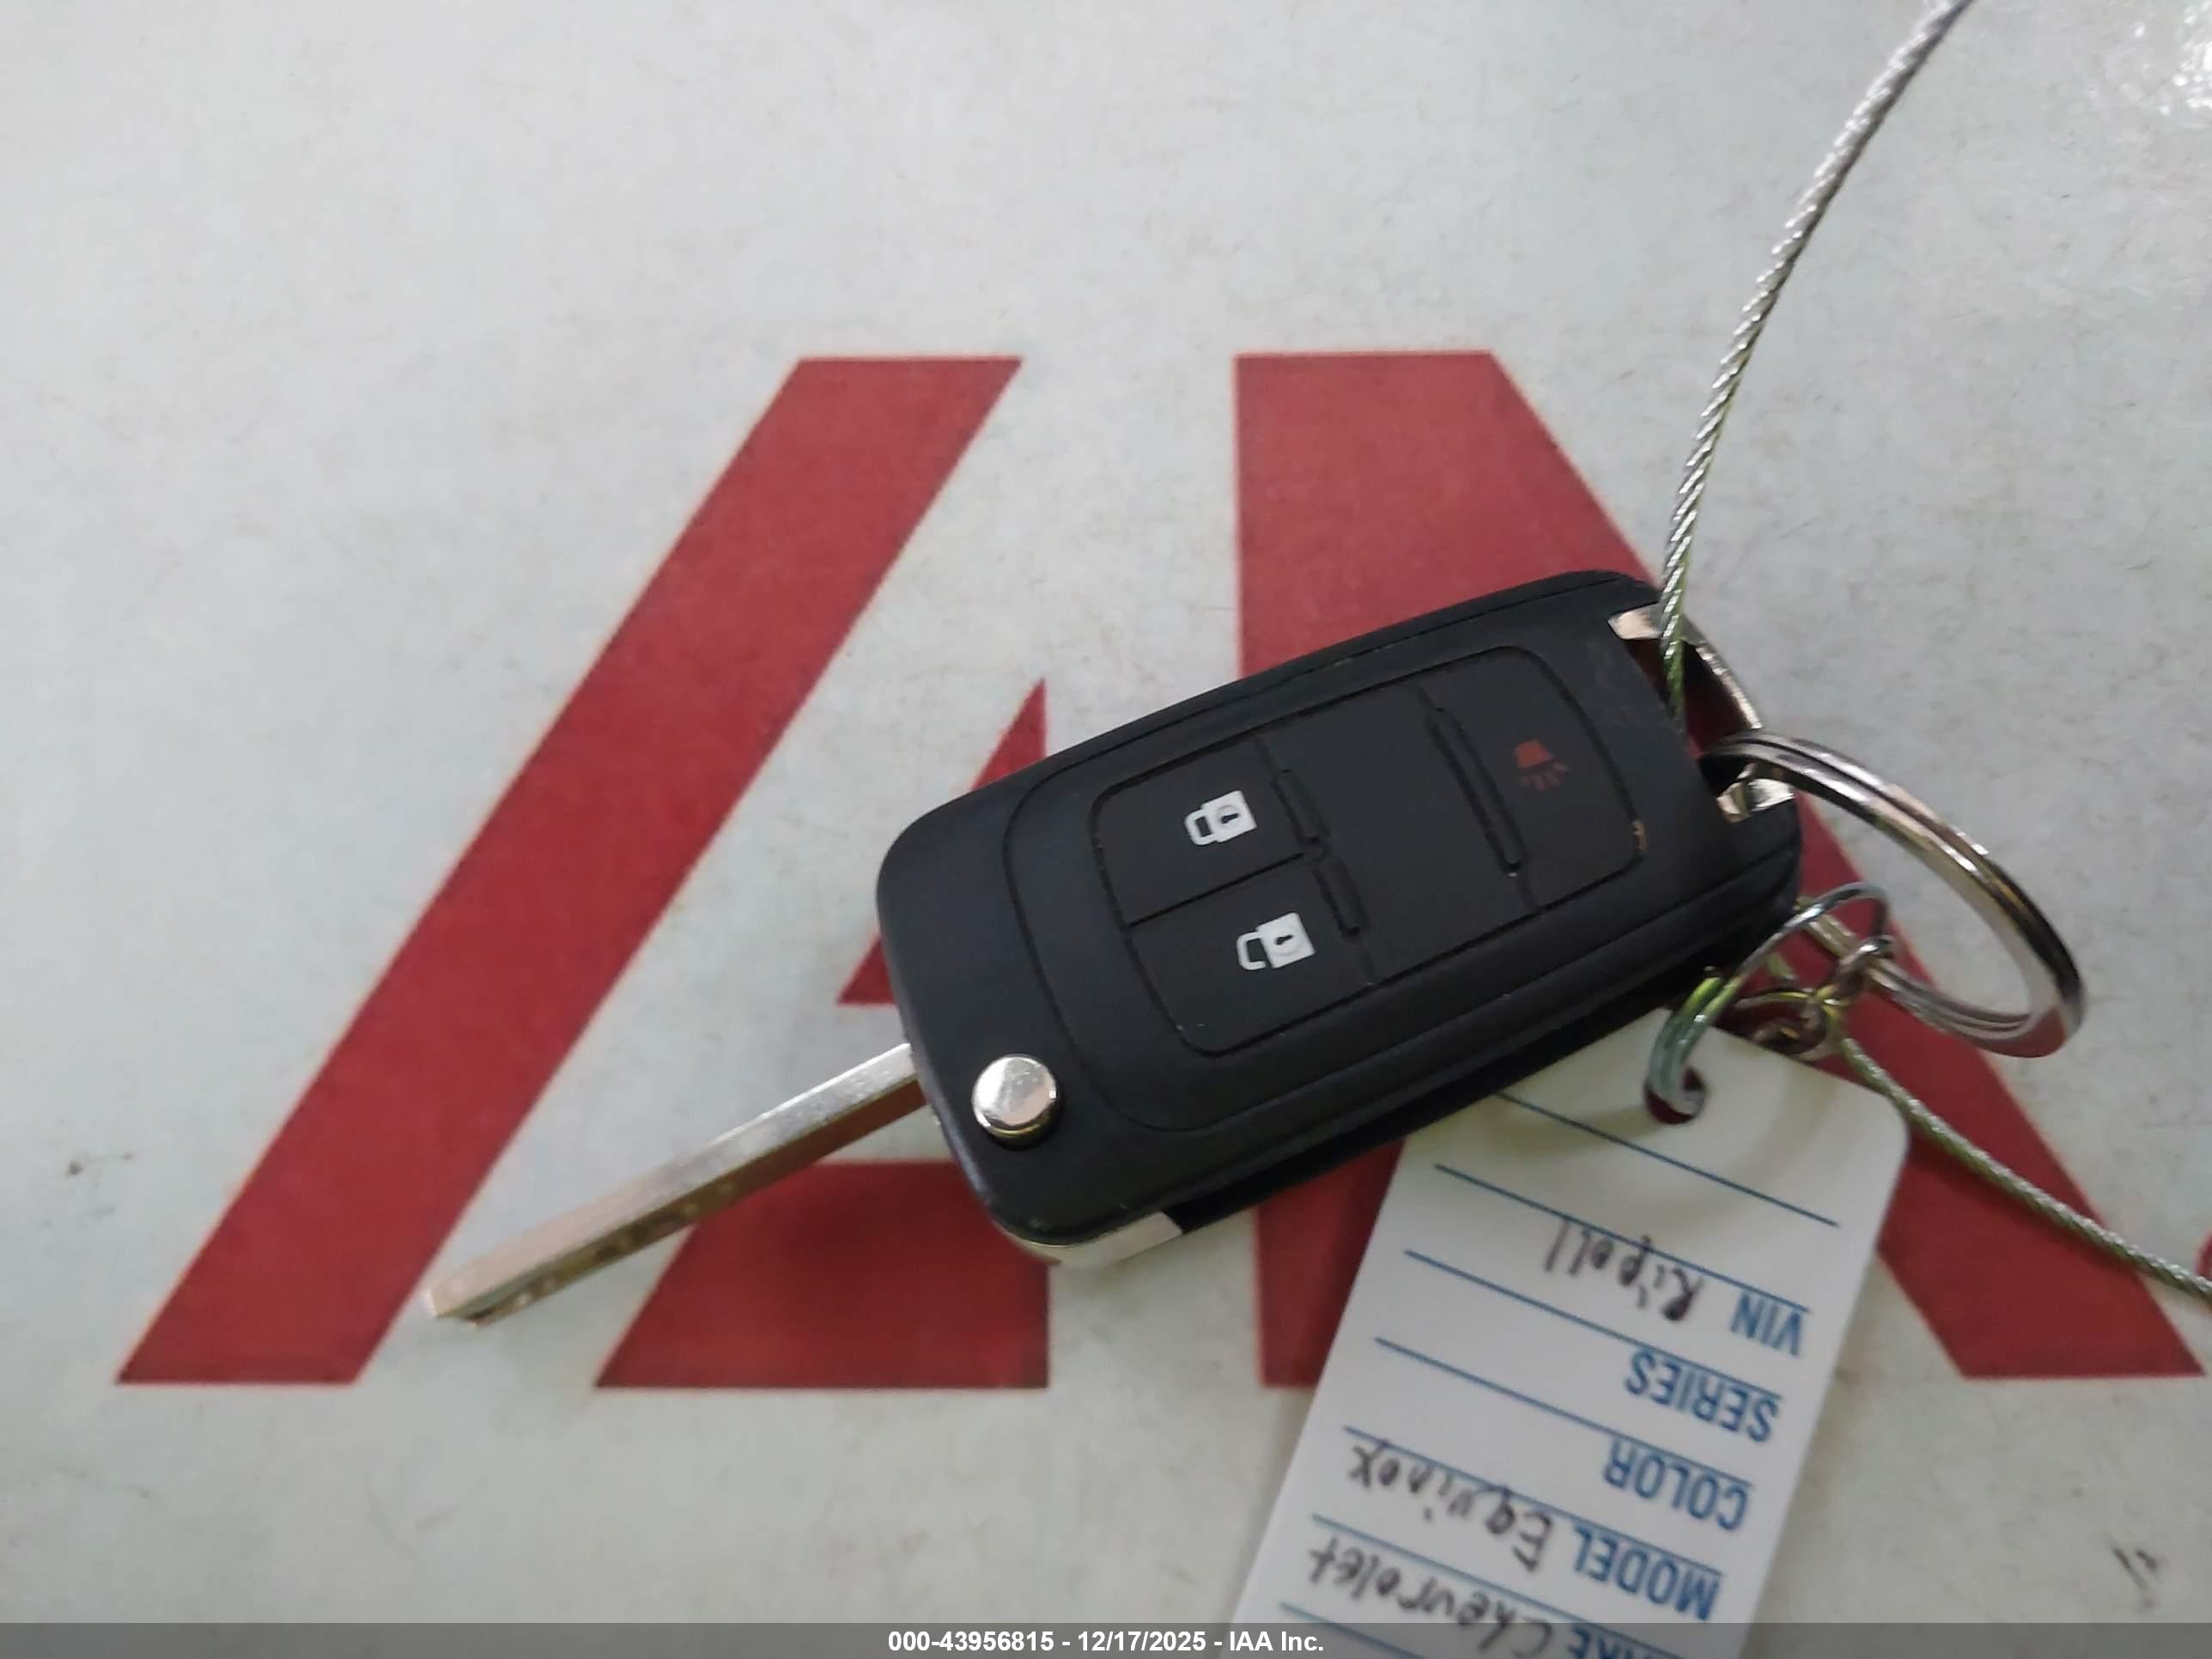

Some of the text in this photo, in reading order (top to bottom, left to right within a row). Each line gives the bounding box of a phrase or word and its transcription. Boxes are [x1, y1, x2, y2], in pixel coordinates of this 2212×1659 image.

[1729, 1291, 1802, 1357] VIN
[1624, 1350, 1779, 1443] SERIES
[1346, 1440, 1721, 1622] MODEL Equinox
[1602, 1437, 1749, 1532] COLOR
[1307, 1537, 1553, 1659] Chevrolet
